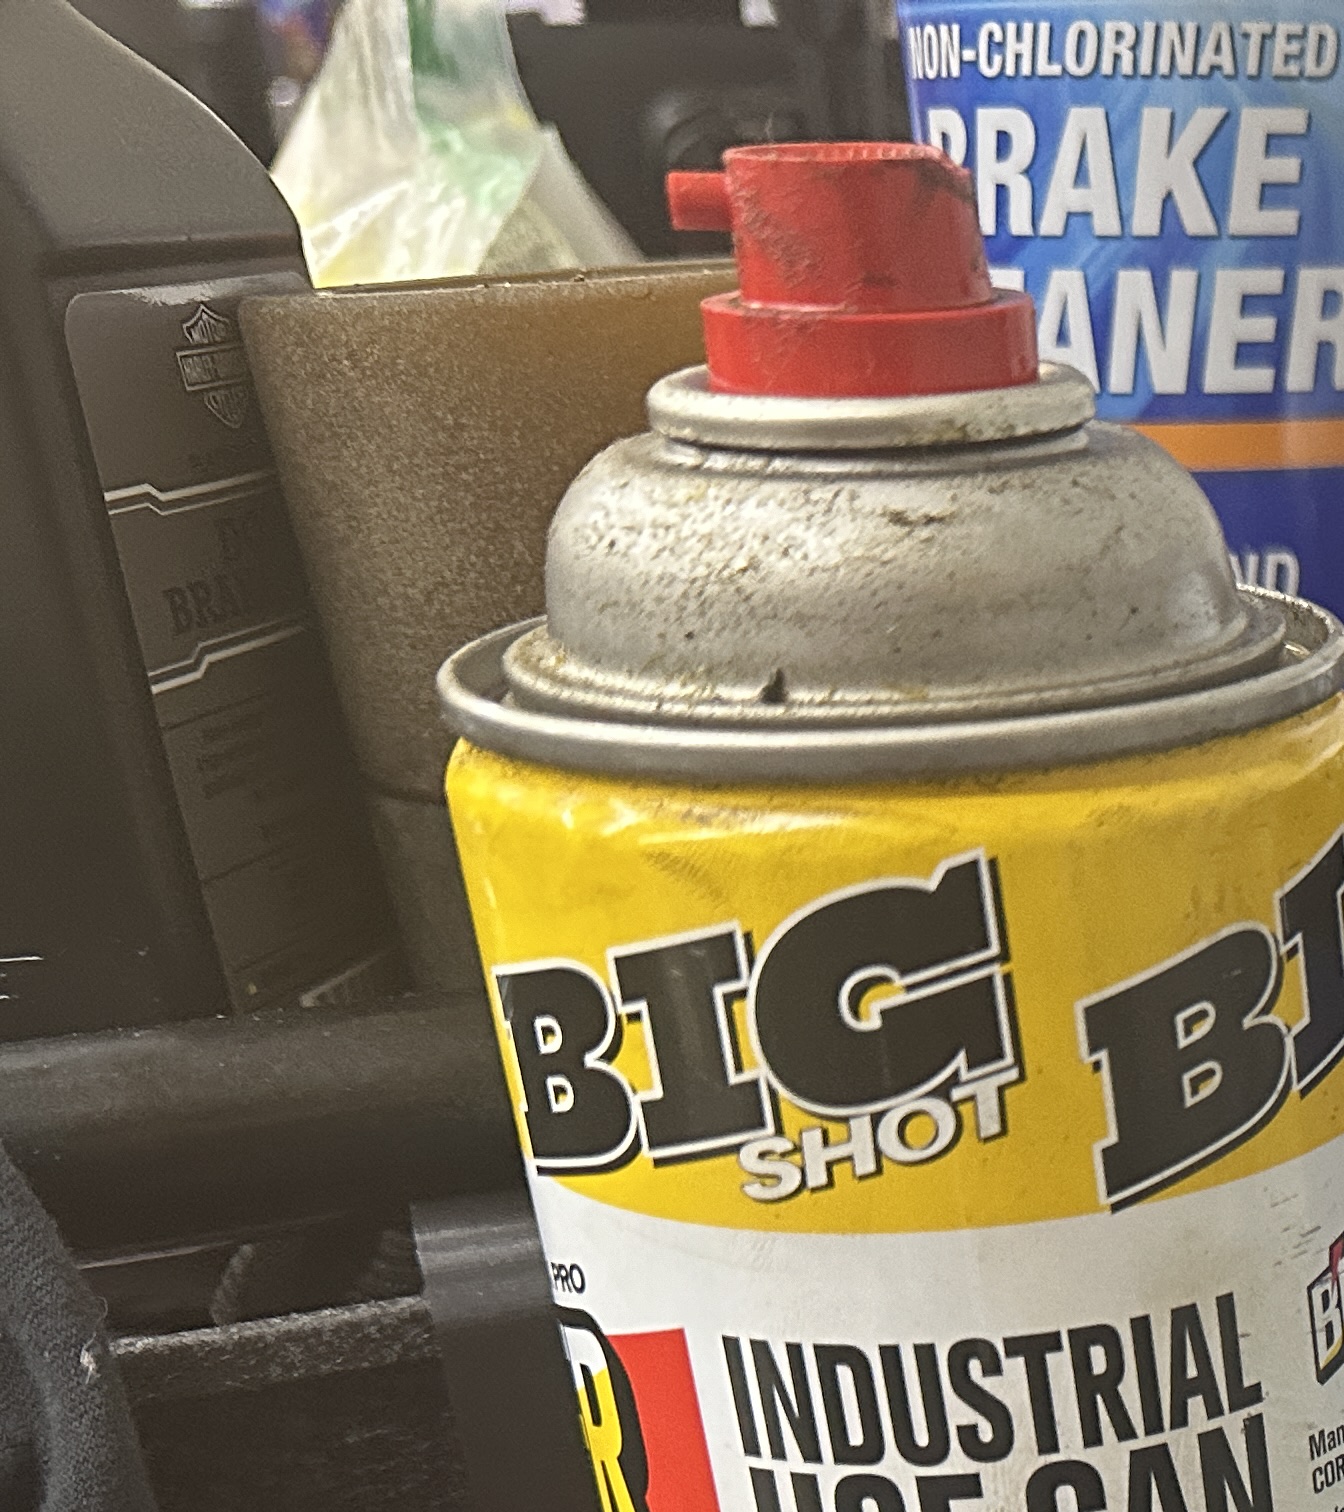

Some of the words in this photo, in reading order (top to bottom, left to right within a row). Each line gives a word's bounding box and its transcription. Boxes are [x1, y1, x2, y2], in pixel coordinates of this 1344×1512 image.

[907, 18, 1341, 81] NON-CHLORINATED
[494, 847, 1014, 1174] BIG
[738, 1068, 1022, 1204] SHOT
[721, 1292, 1265, 1469] INDUSTRIAL
